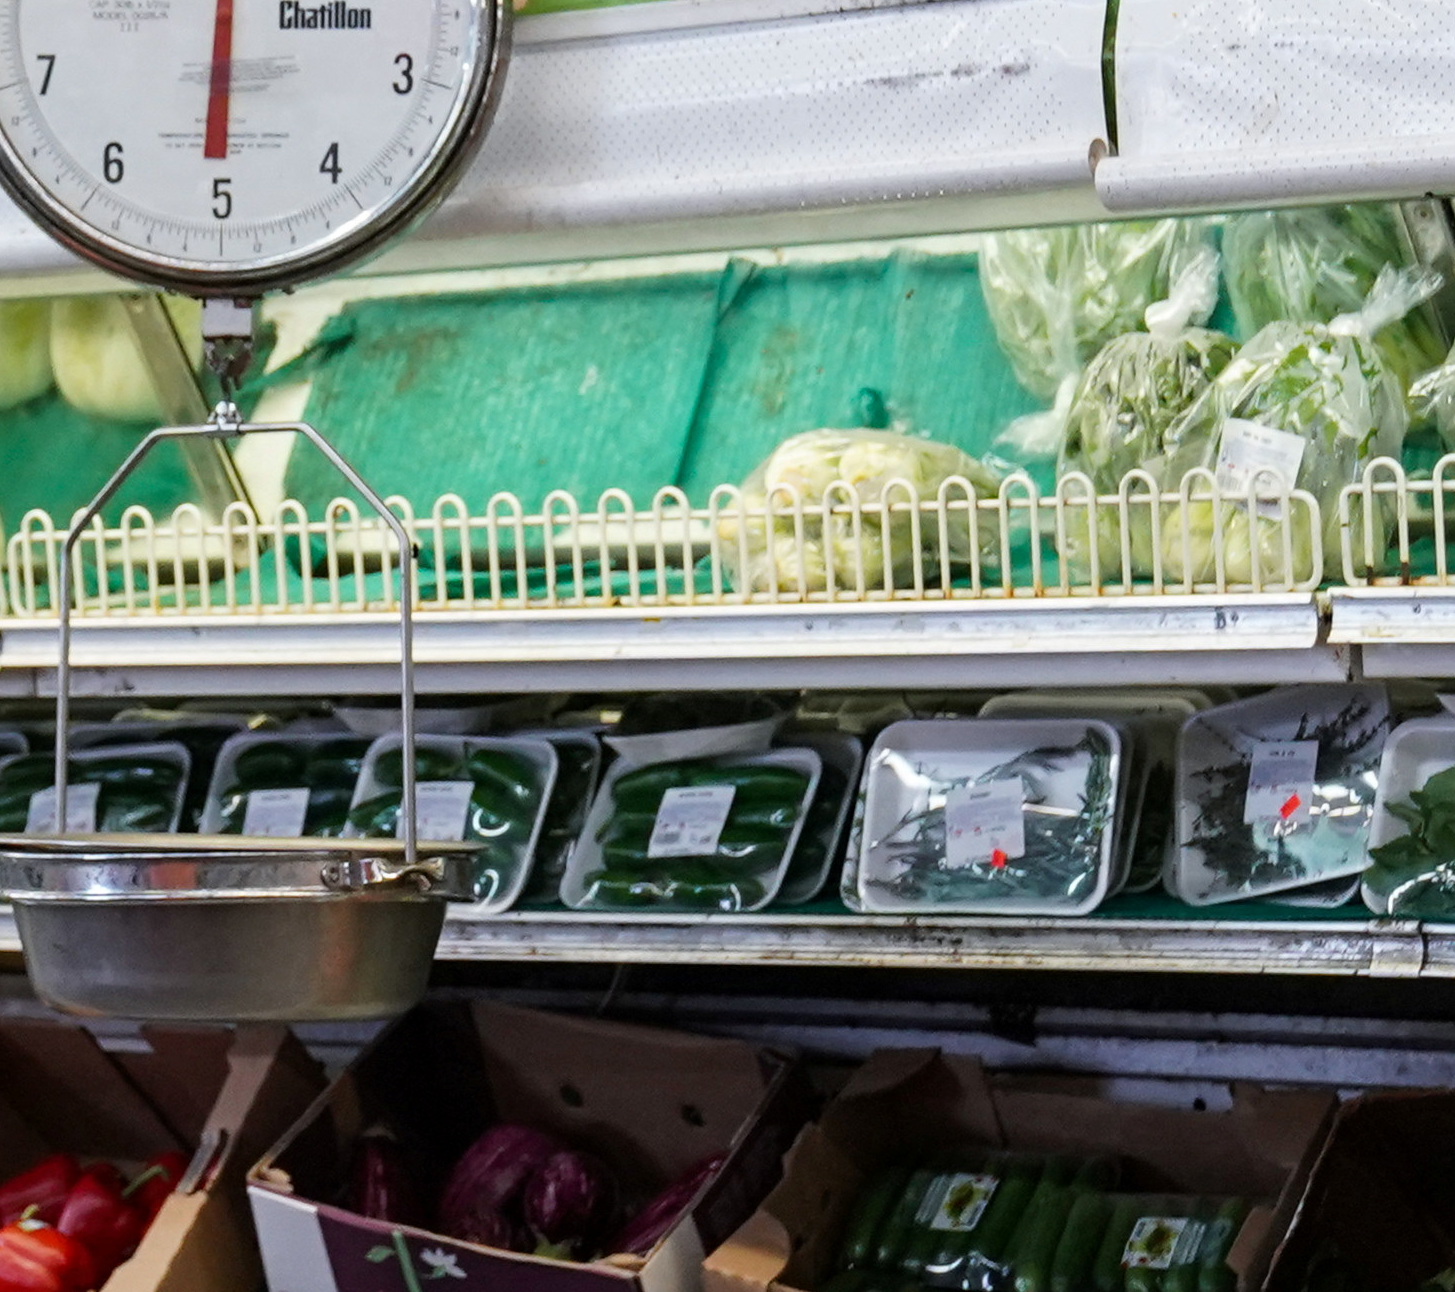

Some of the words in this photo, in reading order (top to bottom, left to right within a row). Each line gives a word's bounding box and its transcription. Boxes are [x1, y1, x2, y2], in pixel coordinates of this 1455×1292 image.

[278, 0, 372, 30] Chatillon
[36, 55, 57, 96] 7
[392, 53, 414, 96] 3
[102, 142, 125, 184] 6
[319, 142, 343, 185] 4
[212, 178, 232, 220] 5
